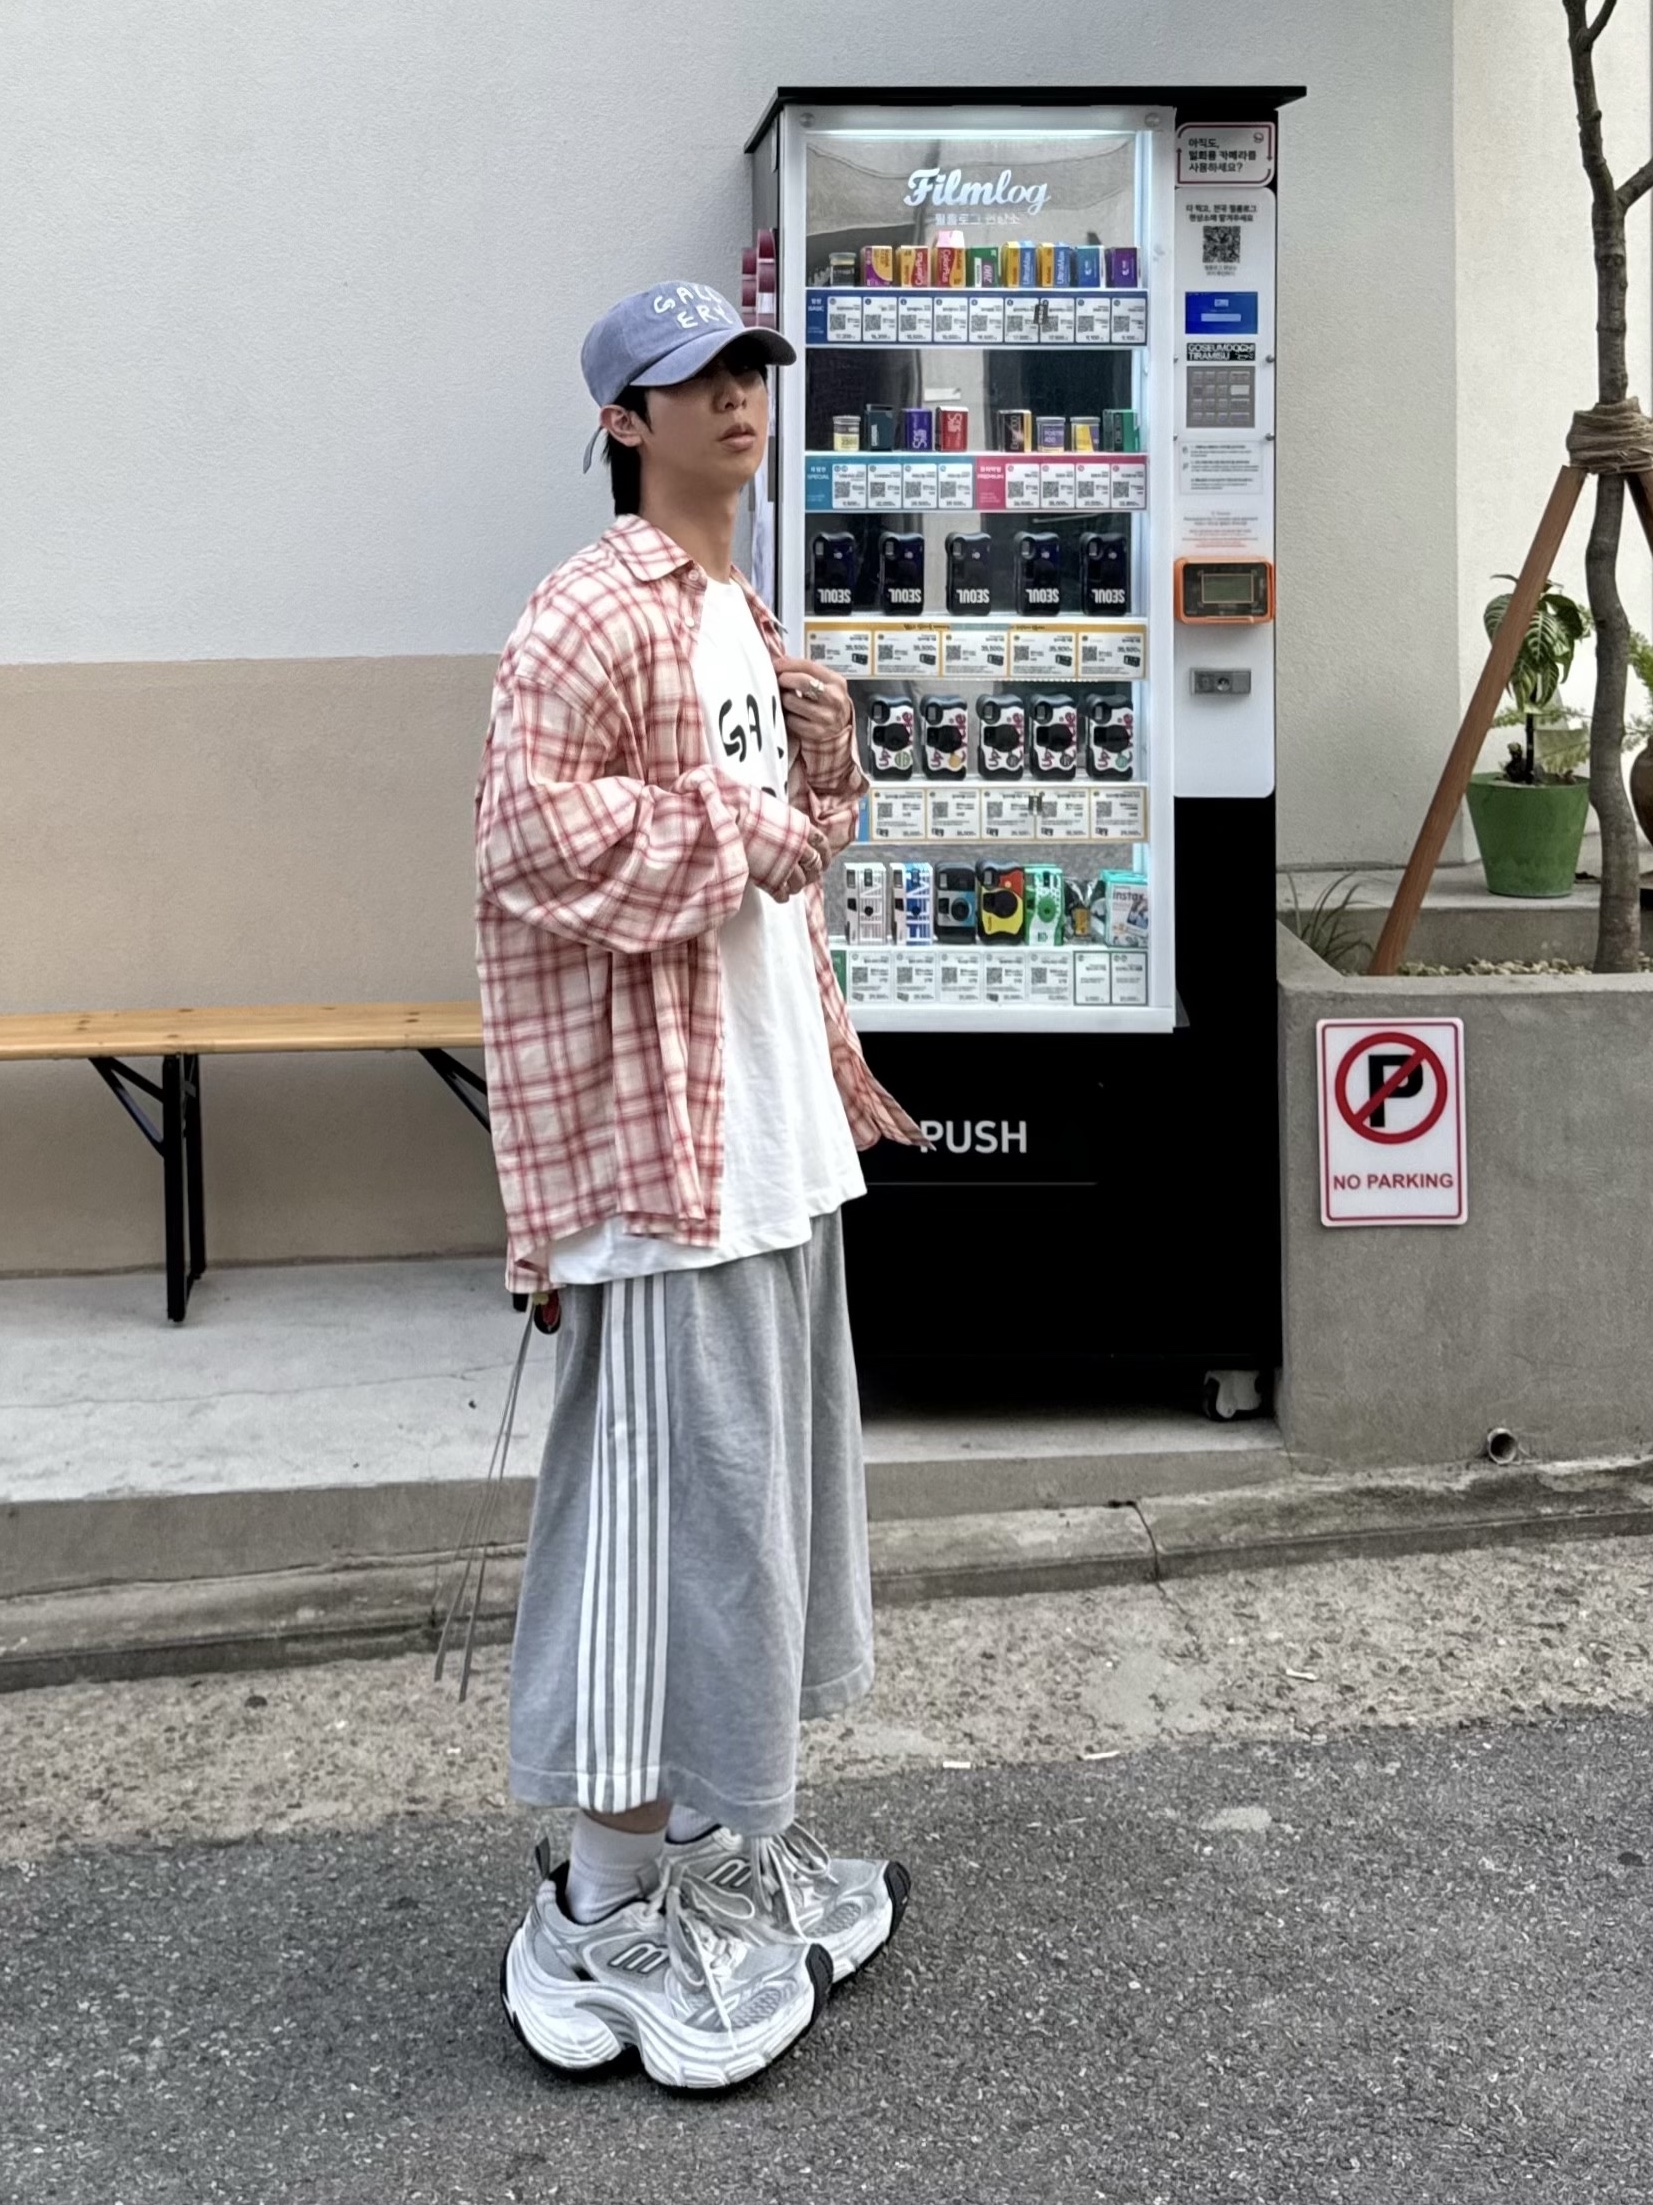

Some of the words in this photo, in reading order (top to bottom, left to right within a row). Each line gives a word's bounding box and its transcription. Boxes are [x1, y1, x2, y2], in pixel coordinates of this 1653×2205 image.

[1188, 138, 1219, 149] 아직도,
[1188, 150, 1216, 161] 일회용
[1219, 150, 1256, 161] 카메라를
[1189, 162, 1243, 173] 사용하세요?
[903, 167, 1051, 216] Filmlog
[915, 251, 924, 286] ColorPlus
[677, 304, 734, 329] ERY
[1188, 352, 1230, 360] TIRAMISU
[818, 588, 851, 604] SEOUL
[888, 588, 921, 604] SEOUL
[956, 588, 990, 604] SEOUL
[1026, 588, 1060, 604] SEOUL
[1092, 588, 1126, 604] SEOUL
[920, 1119, 1027, 1154] PUSH
[1333, 1174, 1361, 1190] NO
[1367, 1173, 1454, 1189] PARKING
